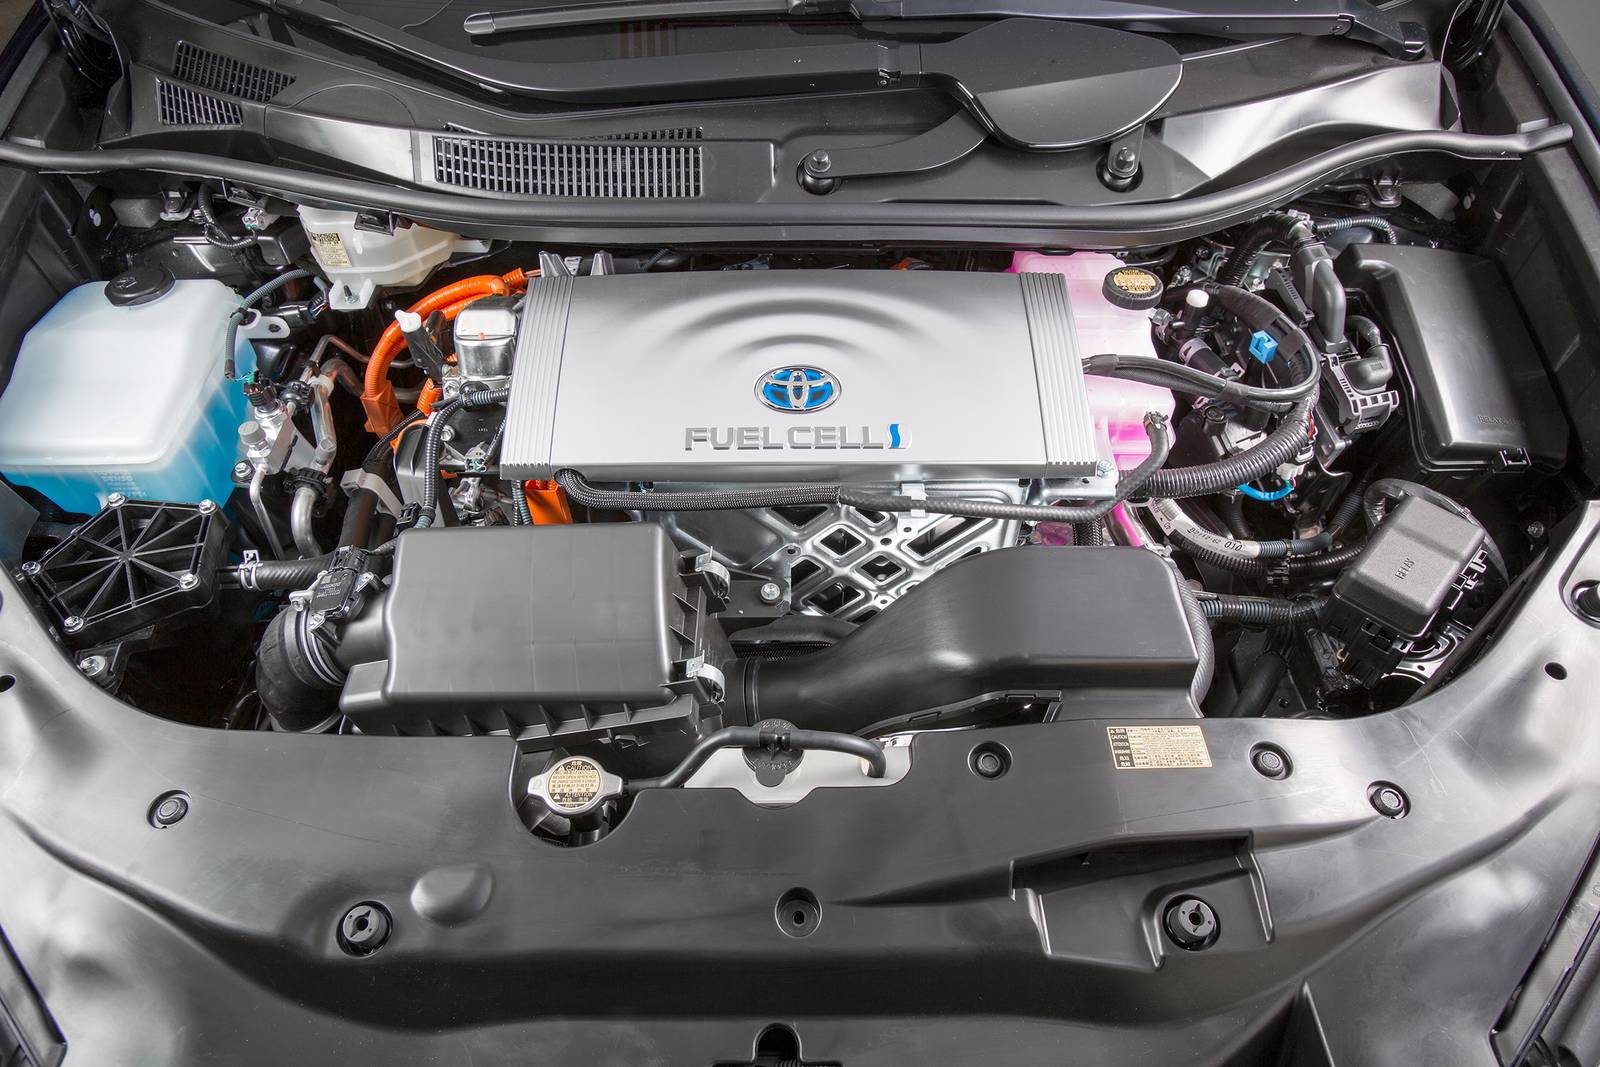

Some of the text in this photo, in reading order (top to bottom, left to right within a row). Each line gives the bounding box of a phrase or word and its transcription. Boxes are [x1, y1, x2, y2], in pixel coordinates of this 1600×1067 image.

[685, 426, 884, 451] FUEL CELL
[1224, 541, 1243, 552] 010
[1395, 557, 1415, 580] RELAY
